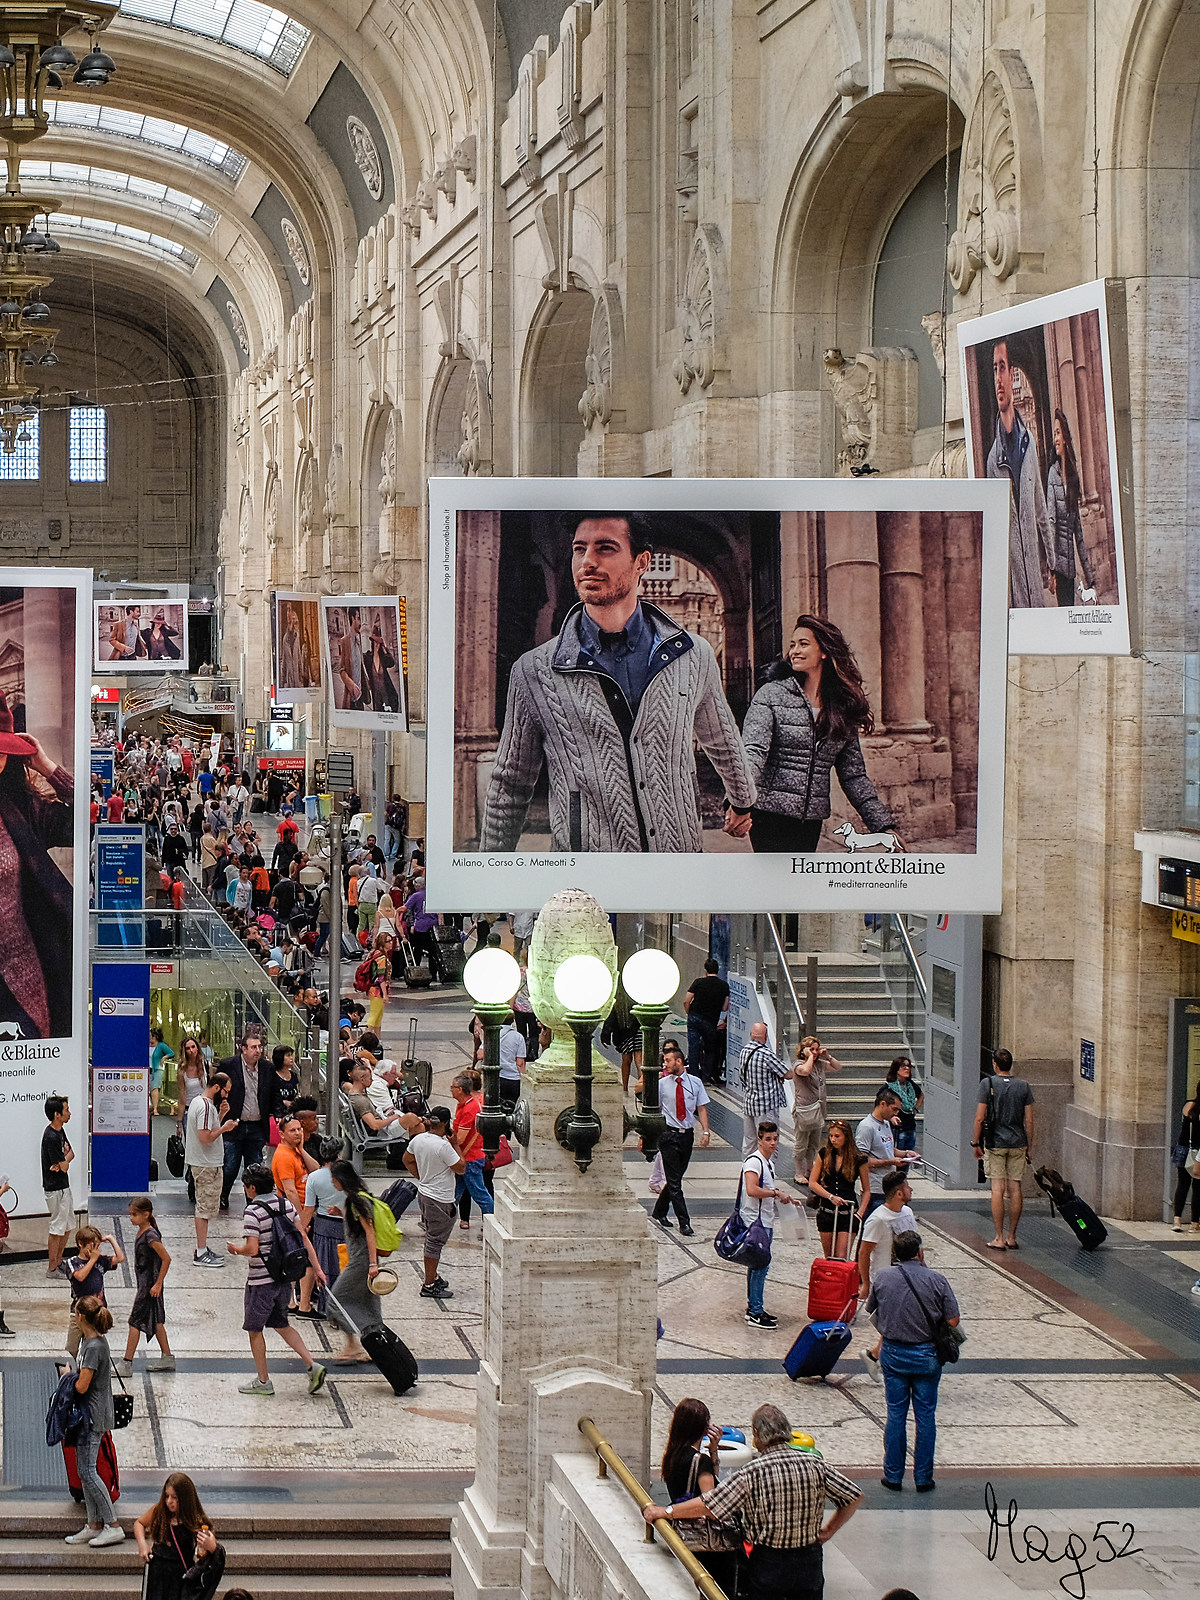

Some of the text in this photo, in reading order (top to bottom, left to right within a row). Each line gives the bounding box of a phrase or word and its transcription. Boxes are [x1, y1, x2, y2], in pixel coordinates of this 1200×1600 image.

[443, 573, 451, 590] Shop
[451, 857, 576, 868] Milano, Corso G. Matteotti 5
[828, 879, 908, 889] #mediterraneanlife
[11, 1091, 49, 1103] Matteotti
